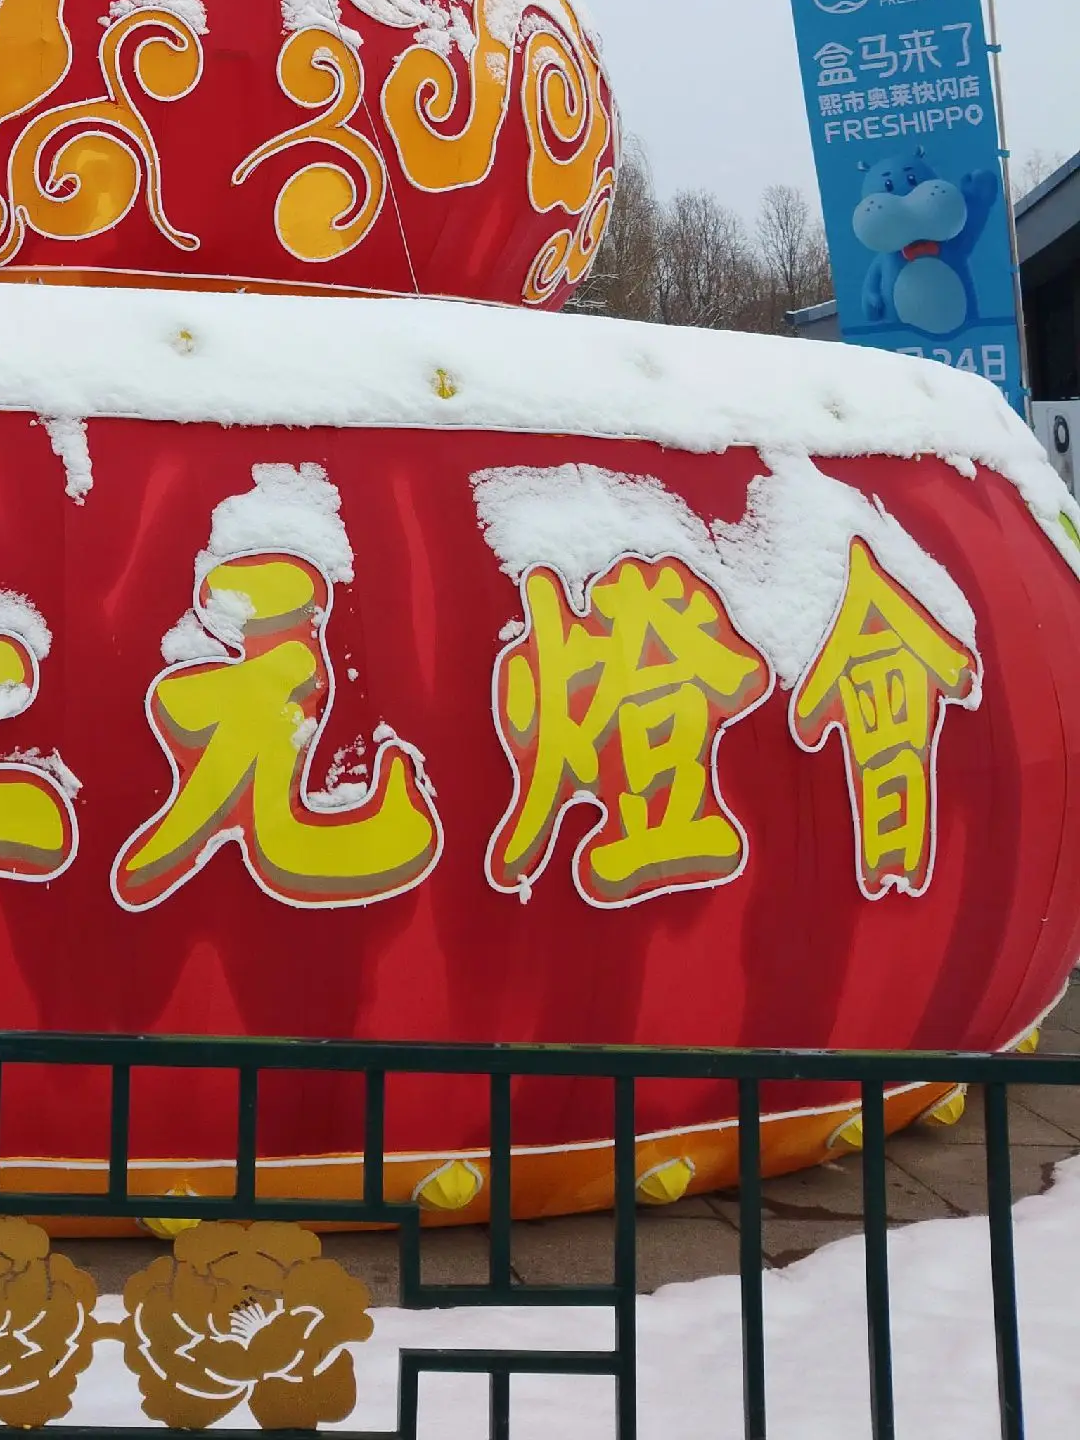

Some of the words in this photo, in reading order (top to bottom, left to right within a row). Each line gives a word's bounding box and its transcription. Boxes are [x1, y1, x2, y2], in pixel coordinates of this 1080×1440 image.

[813, 22, 972, 87] 盒马来了
[824, 104, 984, 144] FRESHIPPO
